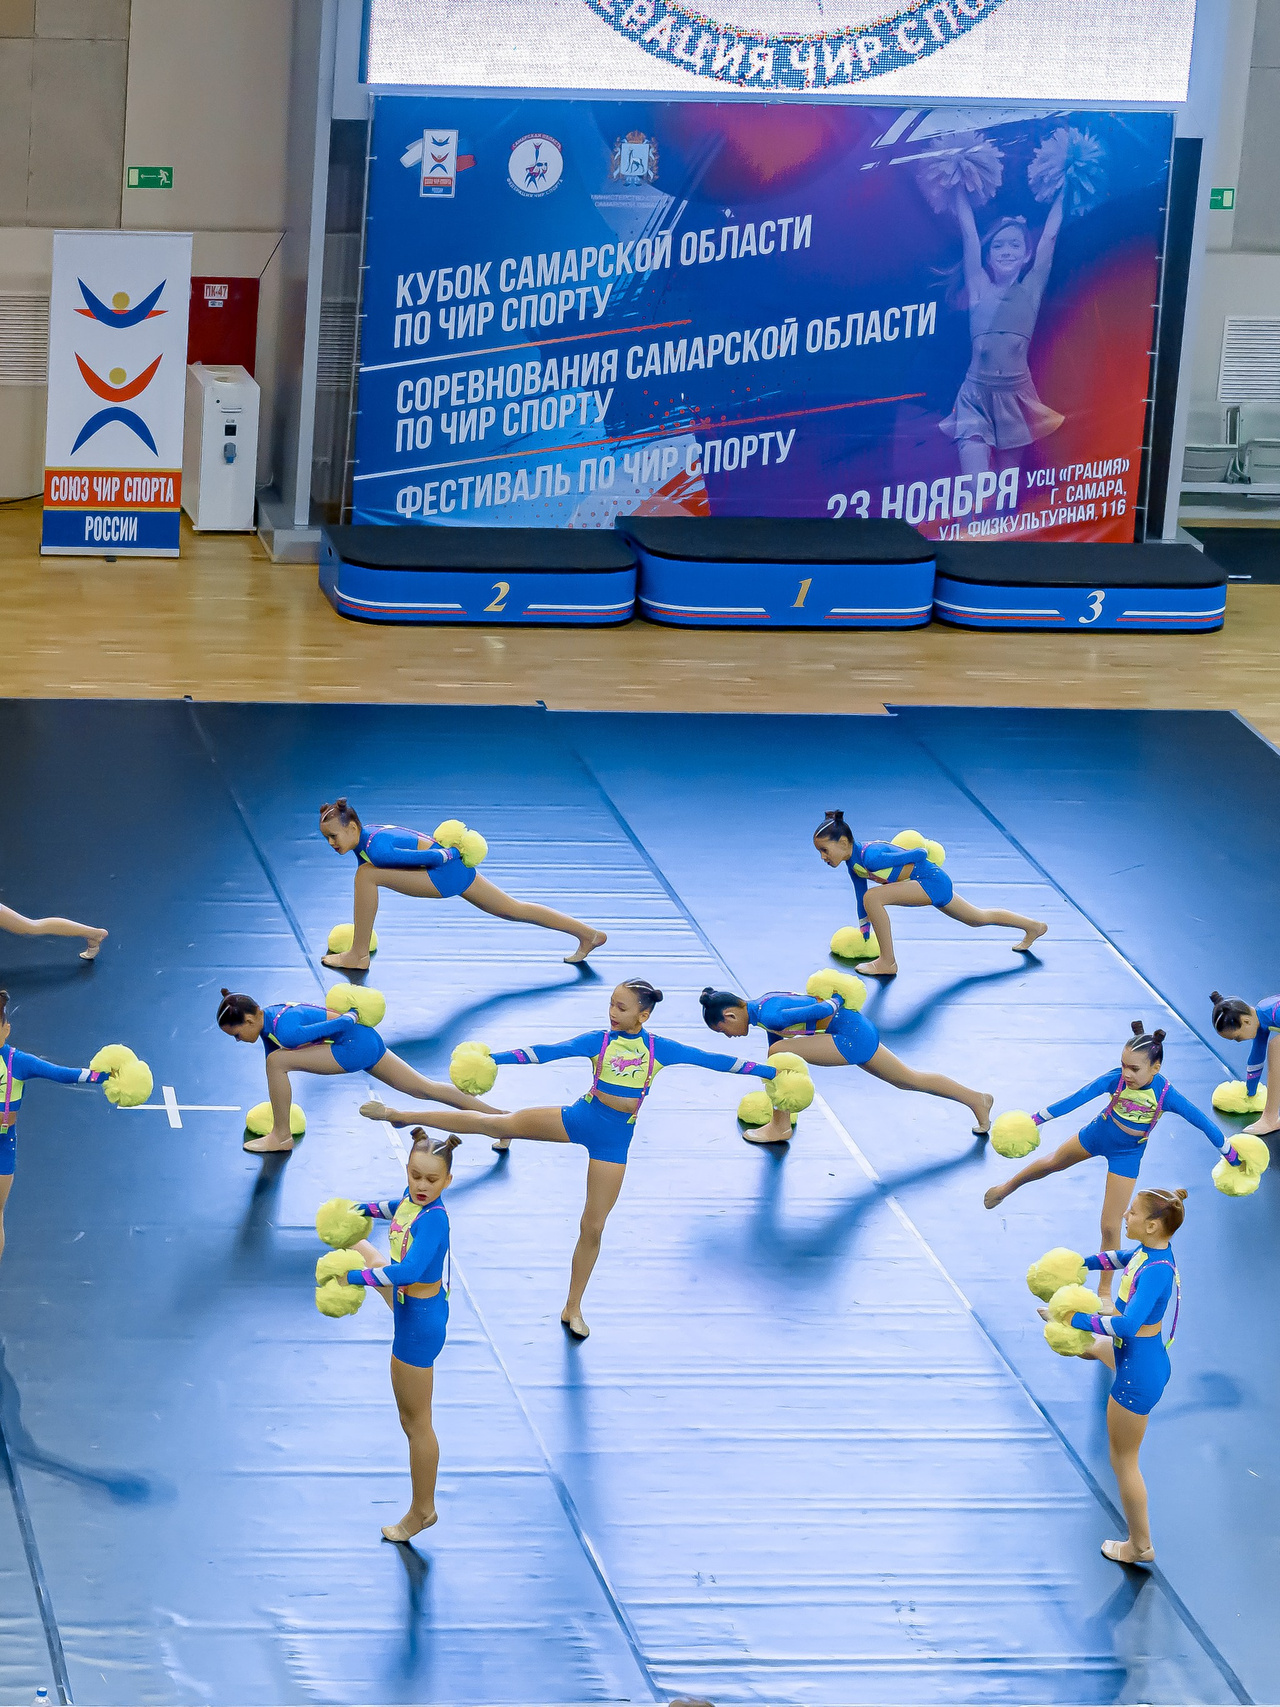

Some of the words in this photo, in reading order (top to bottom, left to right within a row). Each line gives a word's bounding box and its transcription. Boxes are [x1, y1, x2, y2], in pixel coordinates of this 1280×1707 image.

[789, 36, 883, 85] ЧИР
[396, 261, 493, 308] КУБОК
[499, 230, 672, 292] САМАРСКОЙ
[680, 214, 813, 267] ОБЛАСТИ
[394, 311, 431, 348] ПО
[439, 302, 496, 340] ЧИР
[501, 284, 614, 331] СПОРТУ
[396, 348, 618, 414] СОРЕВНОВАНИЯ
[626, 317, 799, 380] САМАРСКОЙ
[806, 301, 937, 354] ОБЛАСТИ
[395, 416, 432, 453] ПО
[441, 406, 496, 444] ЧИР
[502, 388, 615, 437] СПОРТУ
[51, 475, 89, 502] СОЮЗ
[93, 476, 121, 502] ЧИР
[123, 476, 174, 503] СПОРТА
[396, 469, 571, 519] ФЕСТИВАЛЬ
[578, 456, 616, 489] ПО
[622, 445, 679, 485] ЧИР
[685, 429, 797, 477] СПОРТУ
[1026, 467, 1056, 489] УСЦ
[1059, 457, 1130, 482] «ГРАЦИЯ»
[1050, 487, 1062, 506] Г.
[1066, 478, 1128, 503] САМАРА,
[826, 489, 871, 519] 23
[881, 466, 1020, 525] НОЯБРЯ
[84, 515, 138, 542] РОССИИ
[939, 524, 964, 541] УЛ.
[967, 503, 1099, 538] ФИЗКУЛЬТУРНАЯ,
[1101, 499, 1127, 518] 116
[483, 581, 511, 612] 2
[790, 578, 813, 608] 1
[1078, 590, 1106, 624] 3
